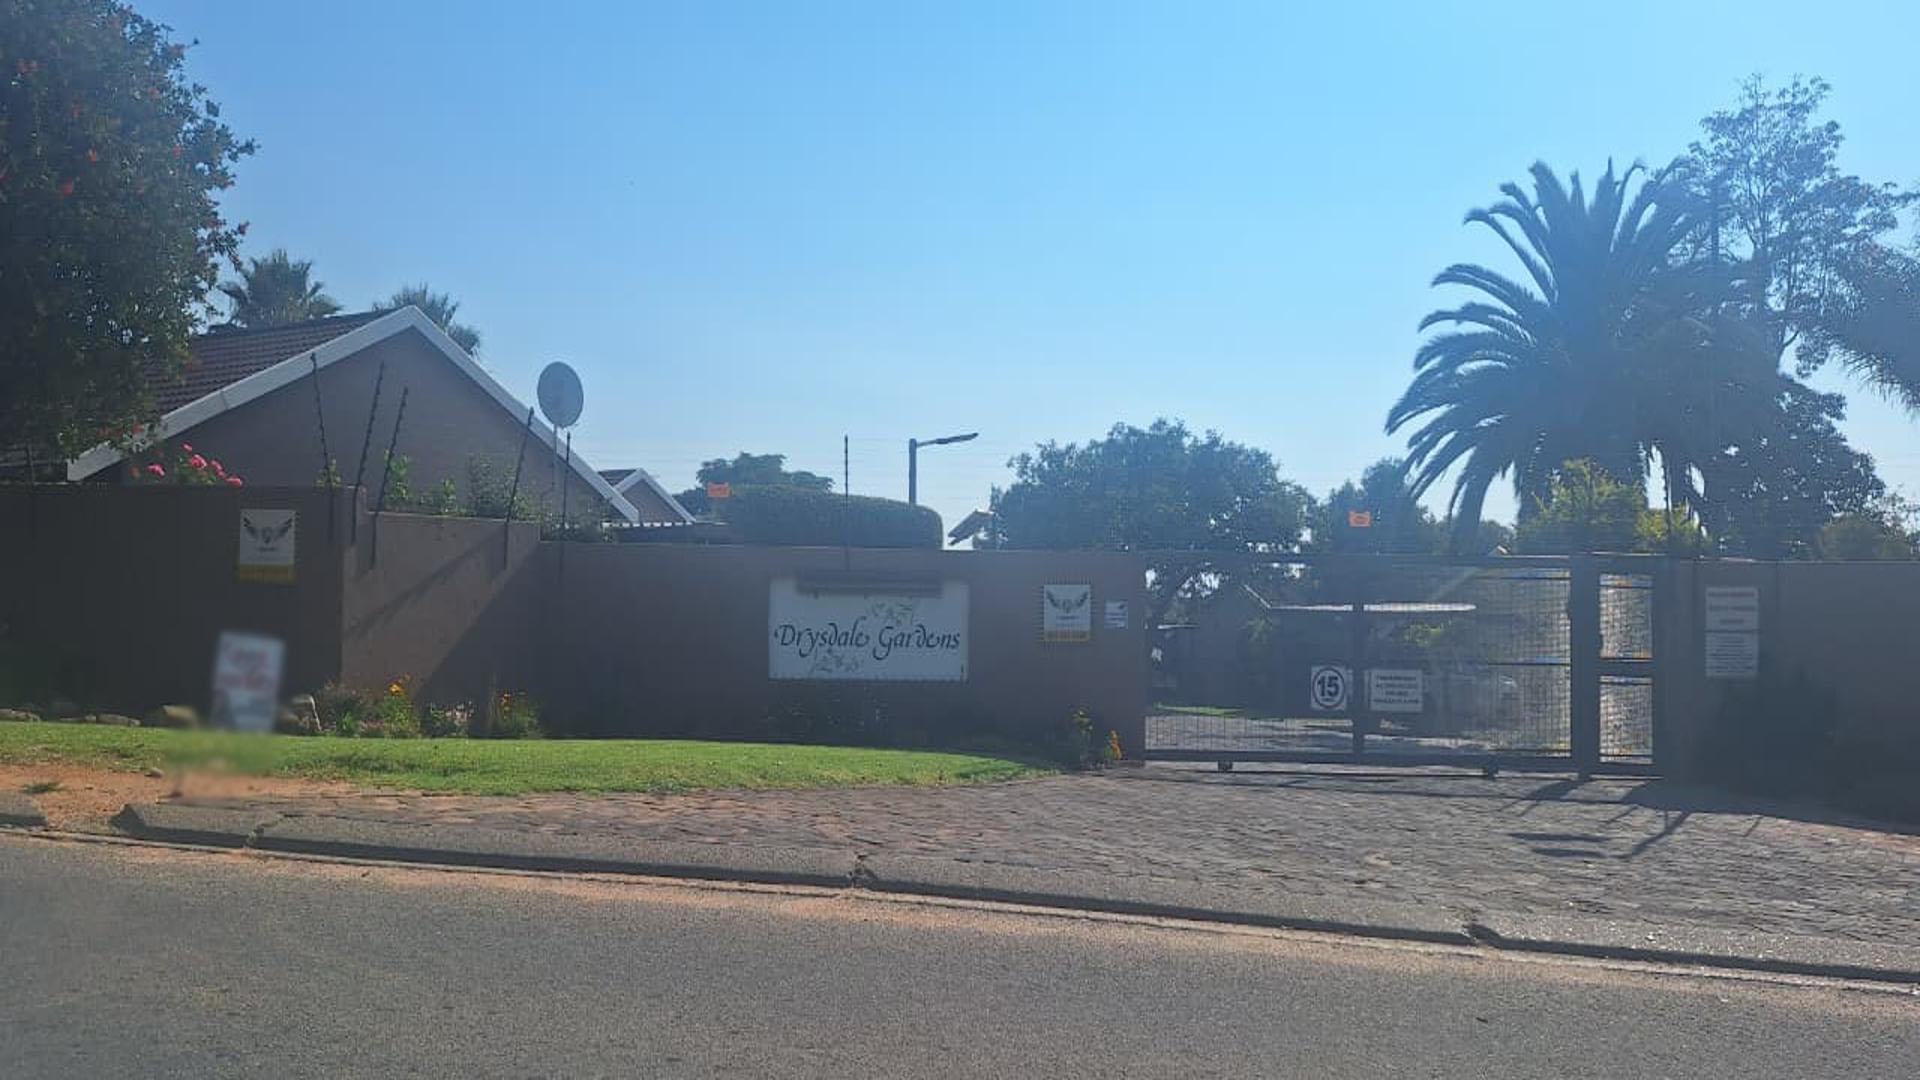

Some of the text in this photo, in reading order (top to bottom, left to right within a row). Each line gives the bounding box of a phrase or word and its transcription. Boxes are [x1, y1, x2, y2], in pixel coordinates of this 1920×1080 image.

[774, 616, 961, 660] Drysdale Gardens
[1317, 675, 1340, 697] 15
